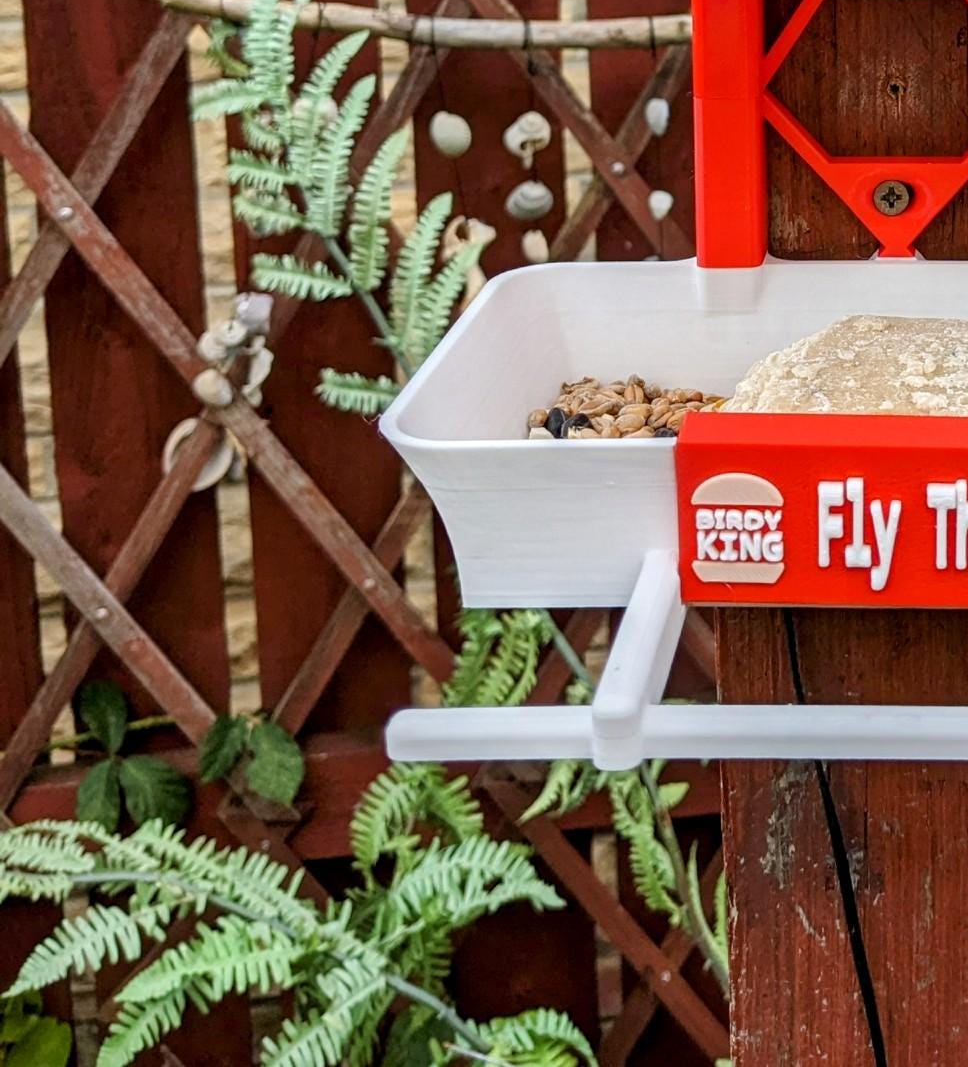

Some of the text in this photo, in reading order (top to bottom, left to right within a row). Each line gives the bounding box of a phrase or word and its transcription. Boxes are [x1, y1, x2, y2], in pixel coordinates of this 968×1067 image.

[695, 508, 782, 531] BIRDY
[817, 477, 901, 591] Fly
[696, 530, 784, 562] KING
